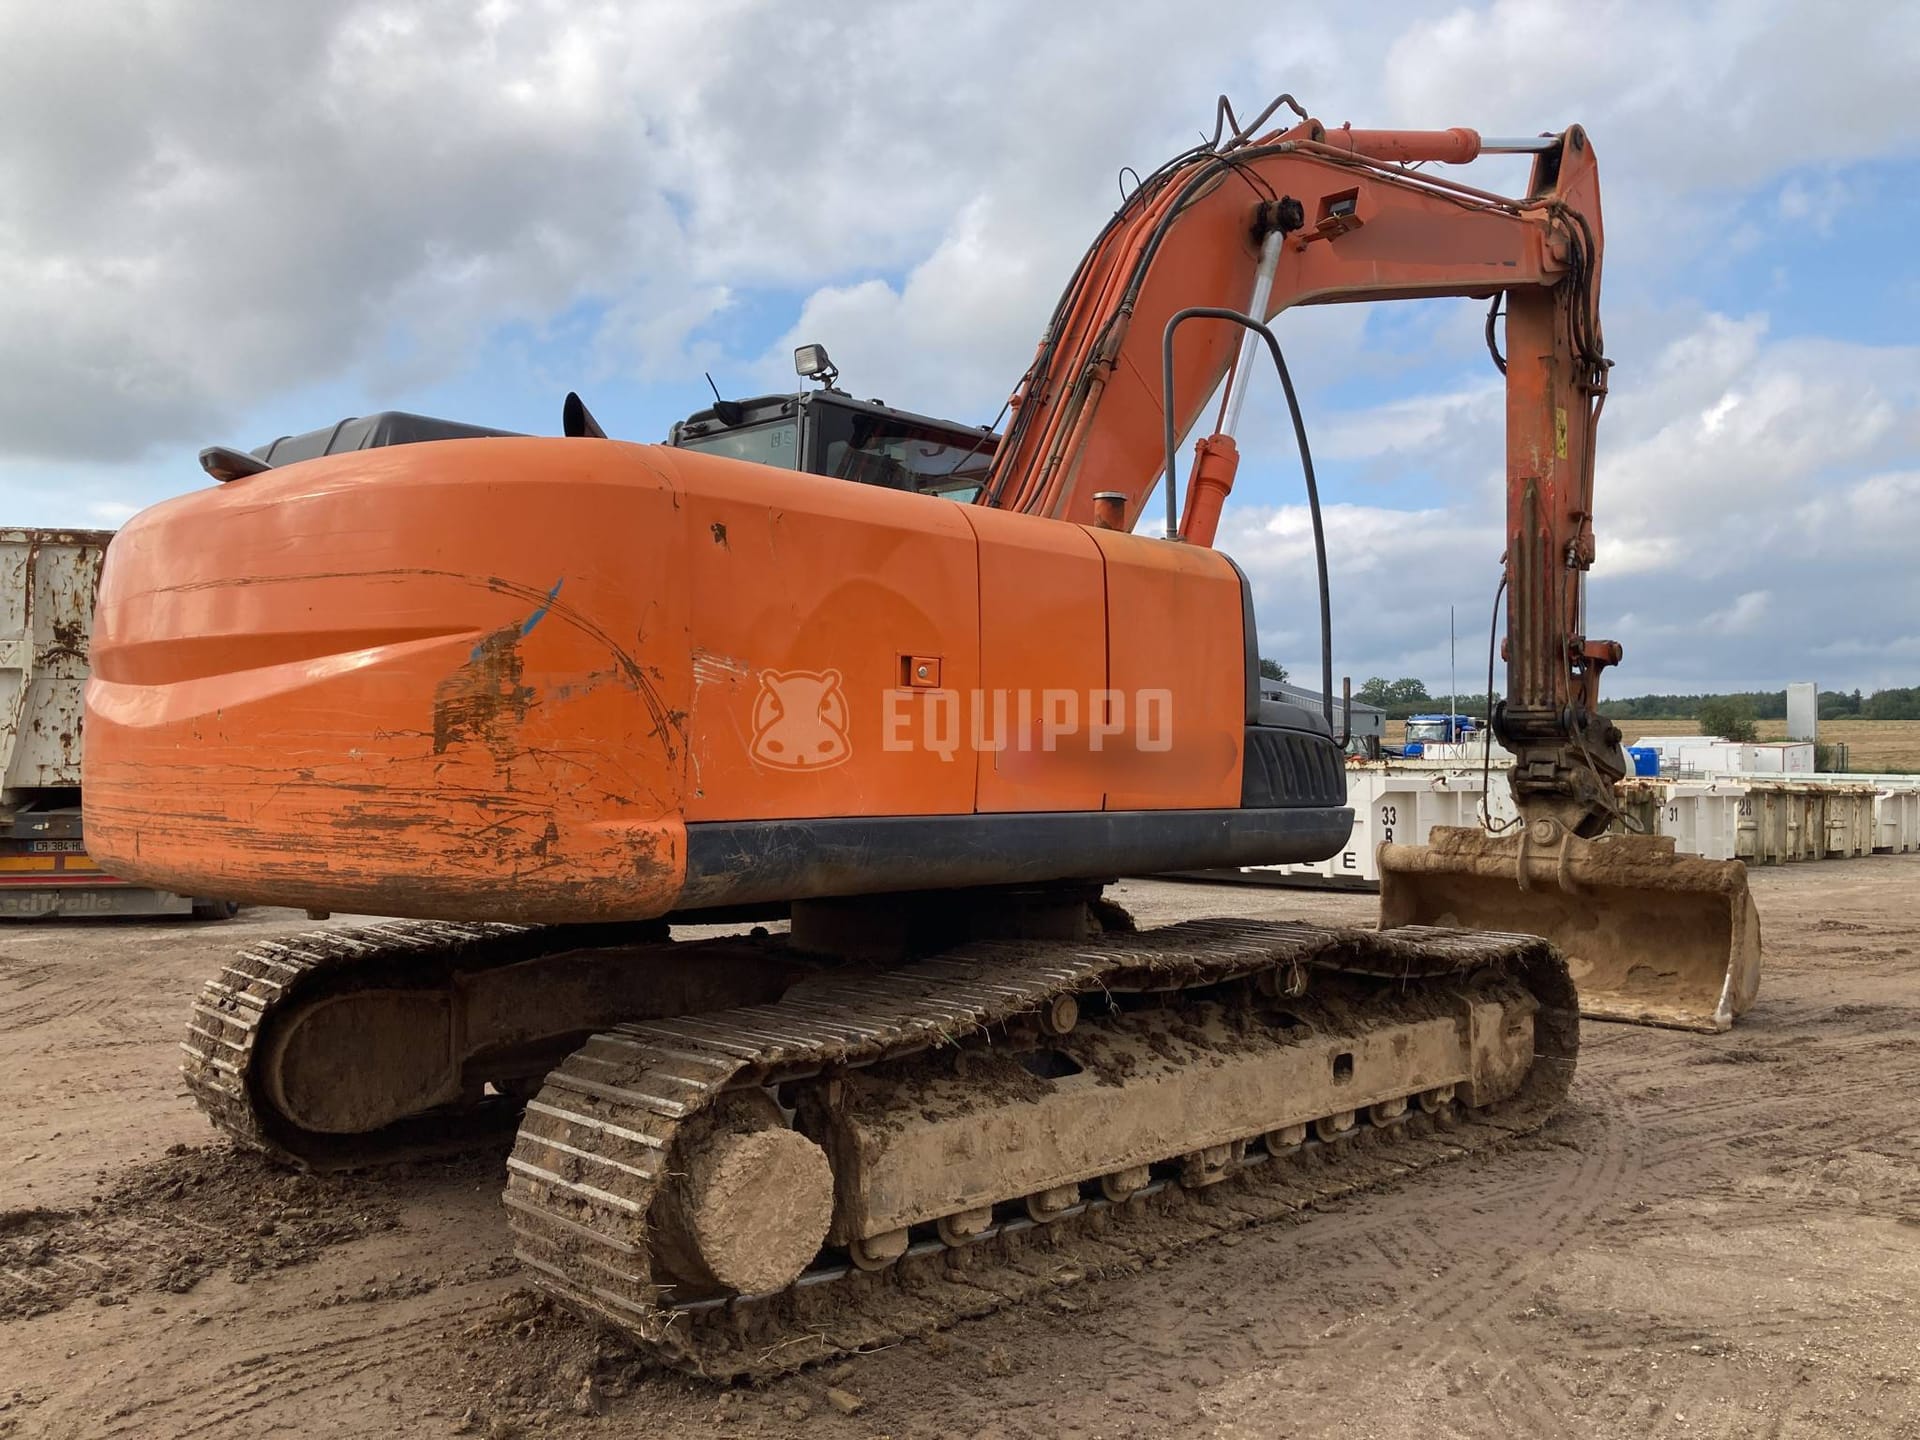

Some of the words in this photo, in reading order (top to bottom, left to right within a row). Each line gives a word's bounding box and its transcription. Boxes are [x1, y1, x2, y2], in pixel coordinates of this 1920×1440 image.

[1381, 806, 1396, 826] 33
[1669, 806, 1678, 822] 31
[1738, 798, 1752, 816] 28
[0, 893, 125, 912] eciTrailer
